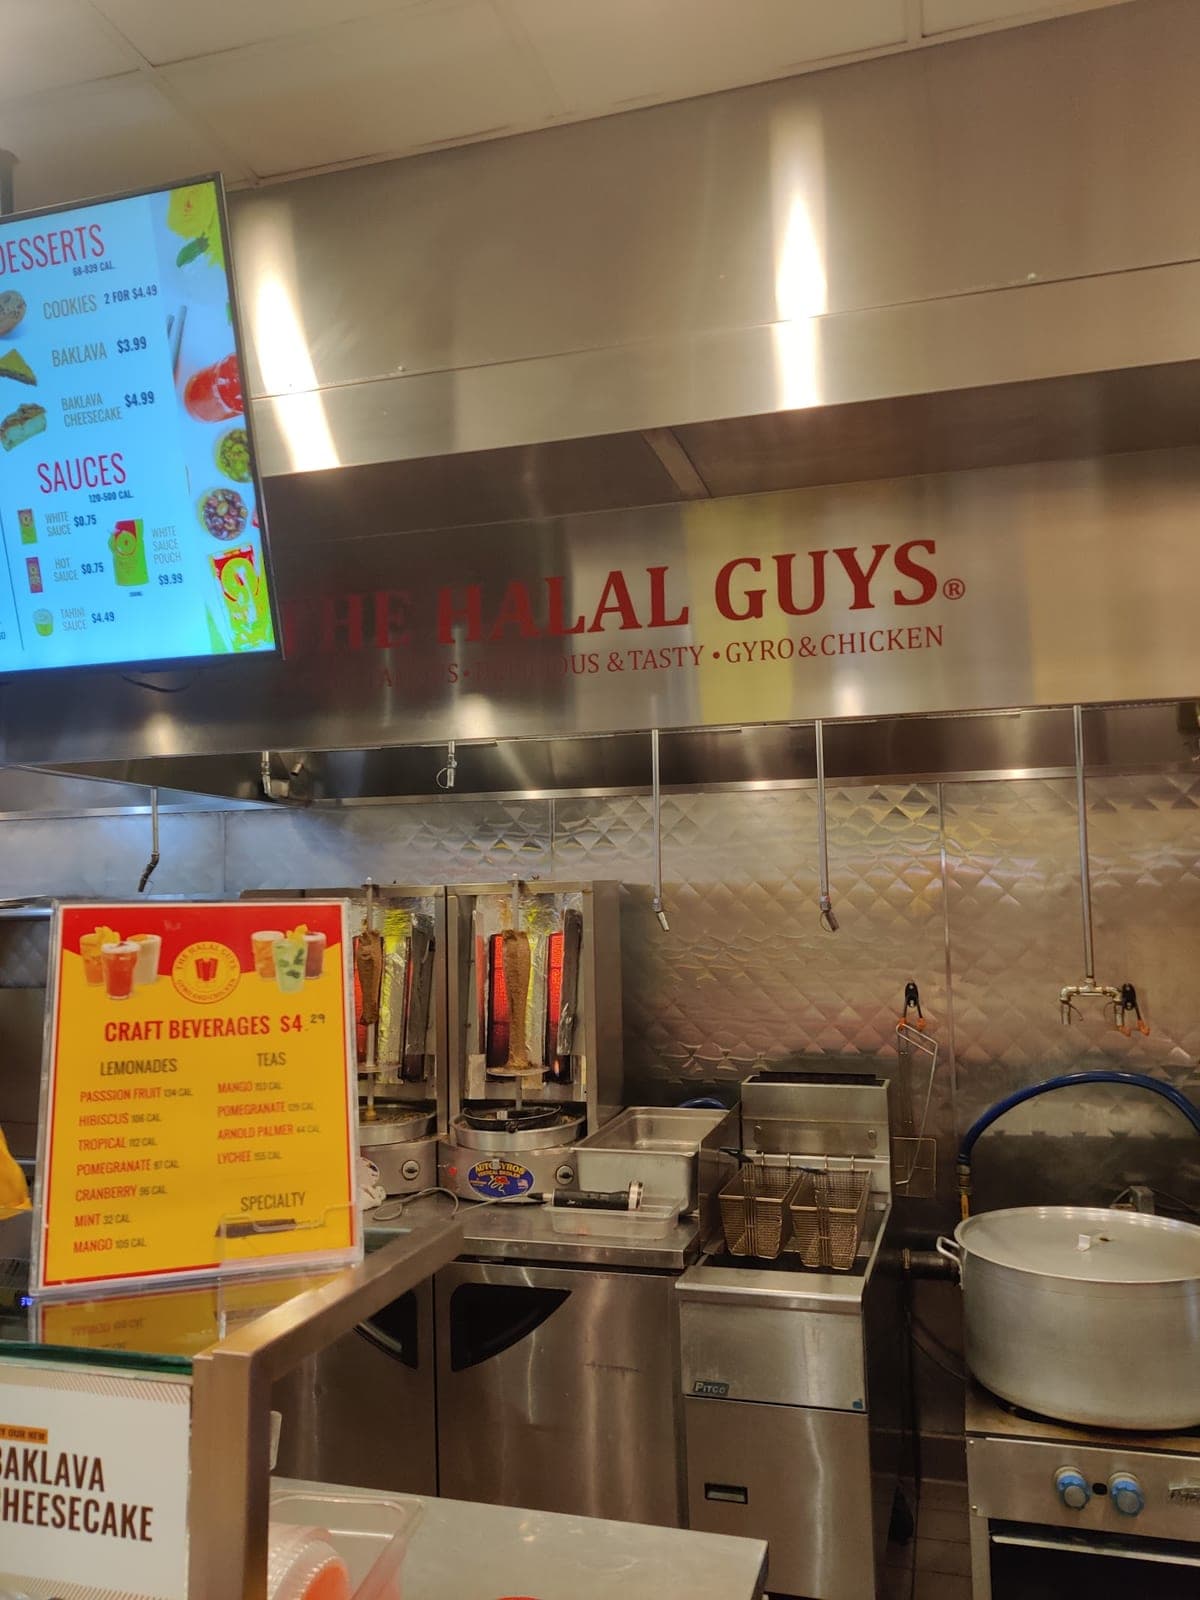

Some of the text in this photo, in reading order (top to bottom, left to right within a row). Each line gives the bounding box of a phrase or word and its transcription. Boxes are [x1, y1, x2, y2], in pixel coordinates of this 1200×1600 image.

[43, 284, 158, 320] COOKIES 2 FOR $4.49
[52, 336, 148, 367] BAKLAVA $3.99
[61, 391, 155, 411] BAKLAVA $4.99
[63, 406, 123, 428] CHEESECAKE
[37, 452, 127, 494] SAUCES
[45, 511, 68, 524] WHITE
[73, 514, 97, 527] $0.75
[46, 524, 71, 537] SAUCE
[151, 525, 176, 538] WHITE
[152, 539, 179, 552] SAUCE
[54, 558, 71, 570] HOT
[153, 552, 182, 565] POUCH
[53, 570, 79, 582] SAUCE
[80, 562, 105, 575] $0.75
[436, 566, 689, 645] HALAL
[60, 608, 85, 619] TAHINI
[91, 611, 115, 623] $4.49
[62, 619, 87, 631] SAUCE
[105, 1021, 163, 1042] CRAFT
[169, 1015, 270, 1040] BEVERAGES
[100, 1058, 177, 1076] LEMONADES
[257, 1052, 286, 1067] TEAS
[133, 1087, 162, 1099] FRUIT
[218, 1081, 253, 1094] MANGO
[217, 1101, 286, 1118] POMEGRANATE
[78, 1113, 129, 1127] HIBISCUS
[217, 1126, 256, 1141] ARNOLD
[257, 1124, 294, 1138] PALMER
[78, 1137, 126, 1151] TROPICAL
[217, 1150, 252, 1165] LYCHEE
[76, 1159, 151, 1176] POMEGRANATE
[75, 1185, 137, 1202] CRANBERRY
[240, 1191, 306, 1212] SPECIALTY
[74, 1213, 101, 1227] MINT
[73, 1238, 113, 1253] MANGO
[0, 1446, 105, 1493] AKLAVA
[0, 1487, 153, 1542] HEESECAKE
